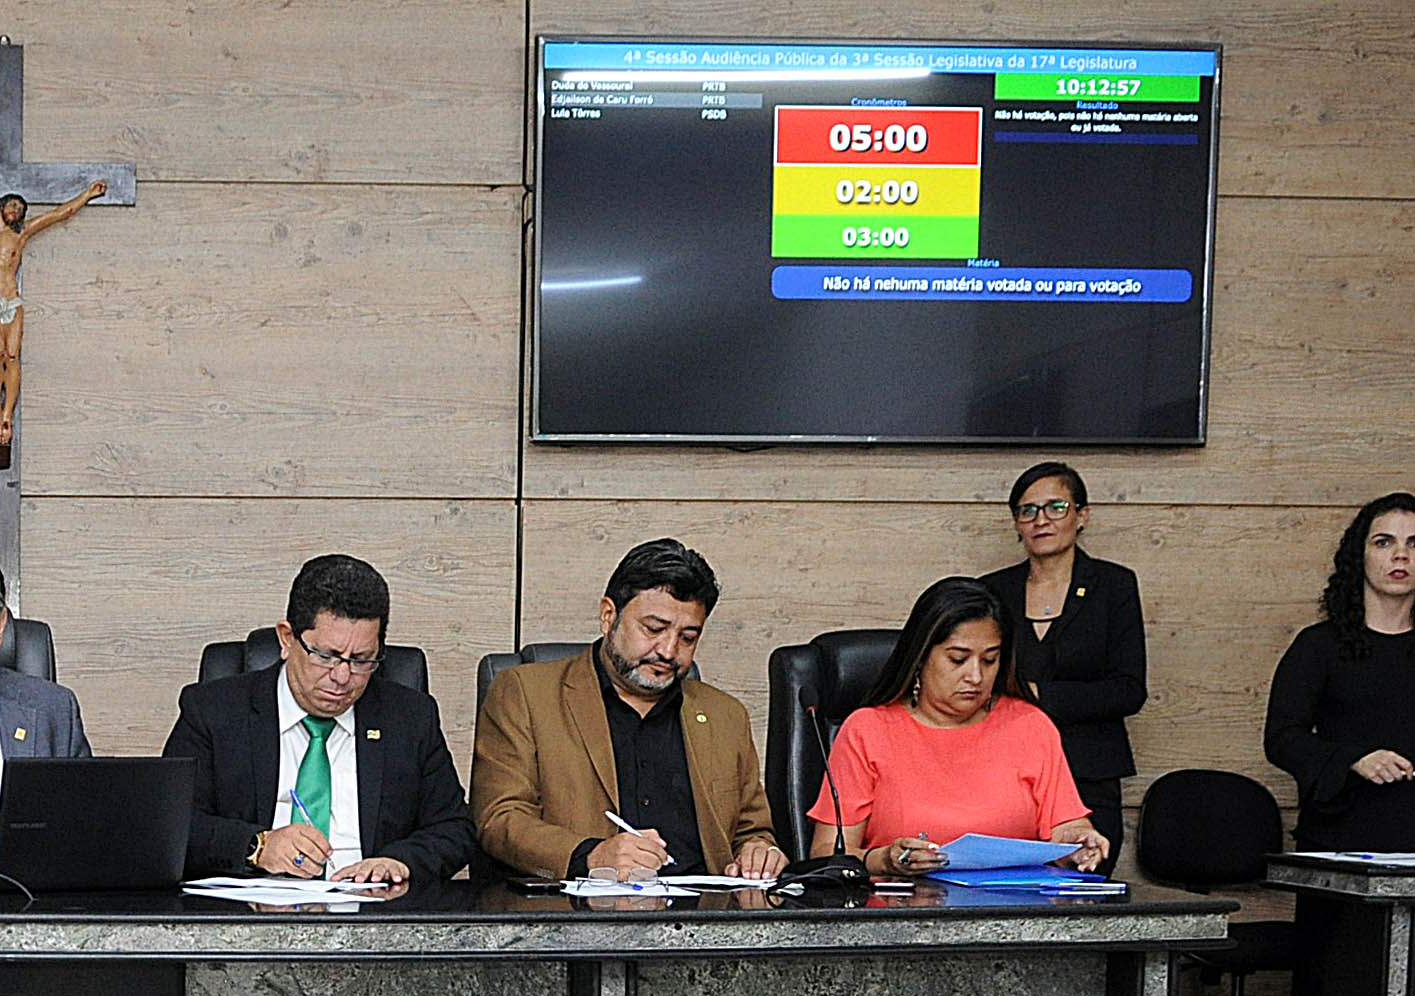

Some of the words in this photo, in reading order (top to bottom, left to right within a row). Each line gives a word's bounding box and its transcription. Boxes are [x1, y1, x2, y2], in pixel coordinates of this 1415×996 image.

[646, 50, 696, 65] Sessão
[701, 50, 769, 65] Audiência
[775, 52, 825, 66] Pública
[830, 53, 847, 66] da
[852, 53, 869, 66] 3ª
[874, 53, 924, 67] Sessão
[929, 54, 1003, 70] Legislativa
[1008, 55, 1025, 67] da
[1031, 56, 1055, 68] 17ª
[1060, 56, 1137, 71] Legislatura
[1056, 79, 1141, 95] 10:12:57
[851, 97, 907, 106] Cronômetros
[1076, 101, 1118, 110] Resultado
[701, 109, 727, 119] PSDB
[829, 124, 927, 151] 05:00
[836, 179, 918, 203] 02:00
[842, 227, 909, 247] 03:00
[967, 258, 1000, 267] Matéria
[823, 276, 850, 290] Não
[853, 276, 870, 290] há
[874, 277, 928, 291] nehuma
[932, 277, 983, 292] matéria
[987, 278, 1032, 292] votada
[1035, 280, 1052, 292] ou
[1056, 280, 1086, 295] para
[1090, 279, 1141, 295] votação
